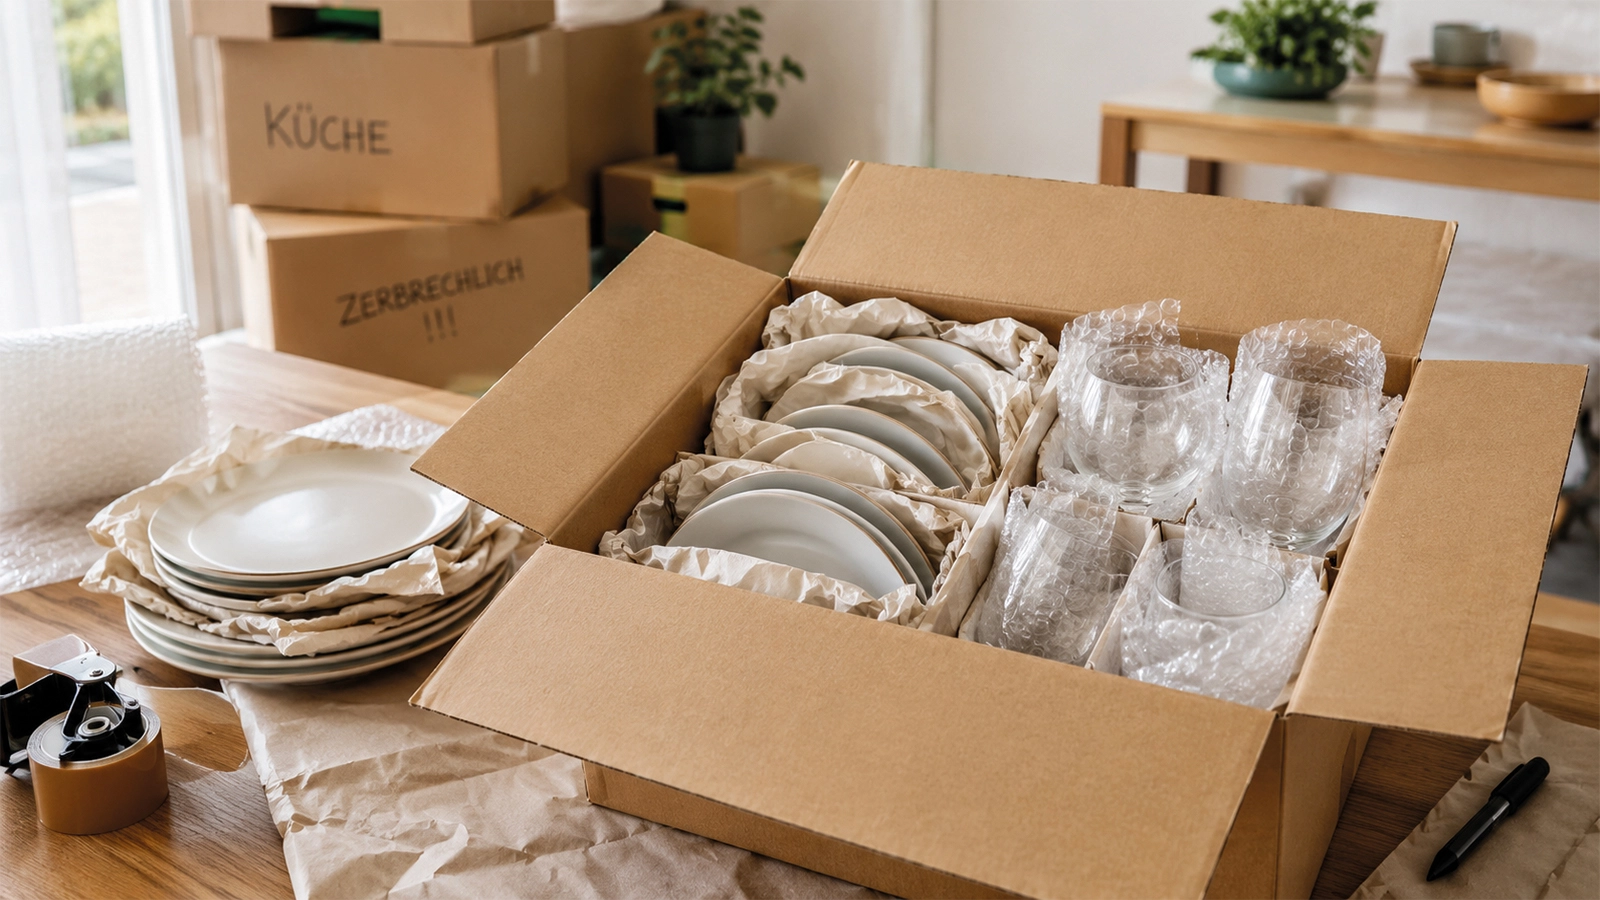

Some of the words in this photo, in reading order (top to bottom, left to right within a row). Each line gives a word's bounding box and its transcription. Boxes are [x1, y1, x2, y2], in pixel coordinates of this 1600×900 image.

[264, 102, 392, 155] KÜCHE
[336, 257, 524, 327] ZERBRECHLICH
[423, 306, 458, 343] !!!
